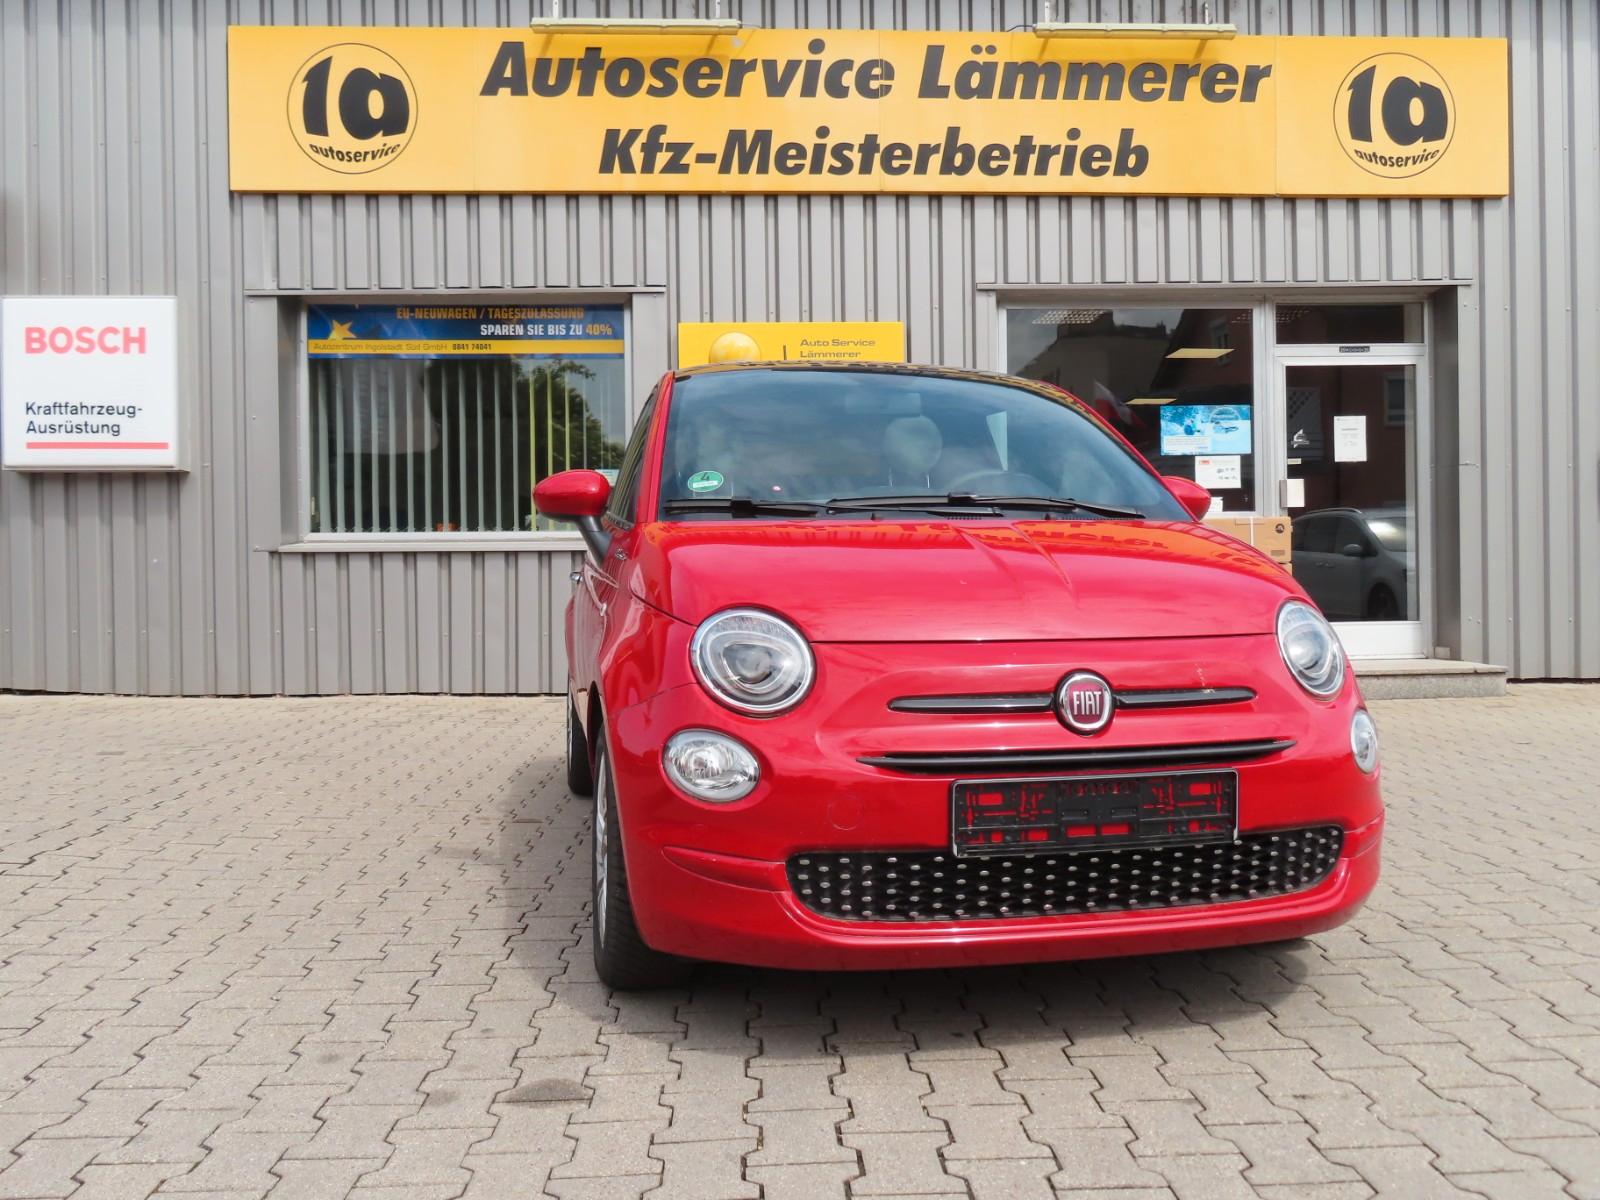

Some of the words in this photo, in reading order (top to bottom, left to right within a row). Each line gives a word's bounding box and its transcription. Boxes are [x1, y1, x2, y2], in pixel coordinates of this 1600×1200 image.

[480, 38, 895, 99] Autoservice
[917, 44, 1273, 103] Lämmerer
[301, 55, 410, 141] 1a
[1347, 64, 1448, 146] 1a
[308, 142, 401, 163] autoservice
[598, 124, 1149, 178] Kfz-Meisterbetrieb
[1353, 148, 1440, 168] autoservice
[396, 307, 477, 319] EU-NEUWAGEN
[487, 307, 585, 320] TAGESZULASSUNG
[480, 324, 524, 336] SPAREN
[527, 324, 545, 336] SIE
[547, 324, 567, 336] BIS
[569, 324, 583, 336] ZU
[585, 324, 613, 336] 40%
[24, 326, 147, 355] BOSCH
[800, 338, 830, 348] Auto
[831, 338, 876, 348] Service
[800, 349, 861, 358] Lämmerer
[25, 401, 143, 418] Kraftfahrzeug-
[26, 420, 121, 437] Ausrüstung
[1072, 690, 1102, 716] FIAT
